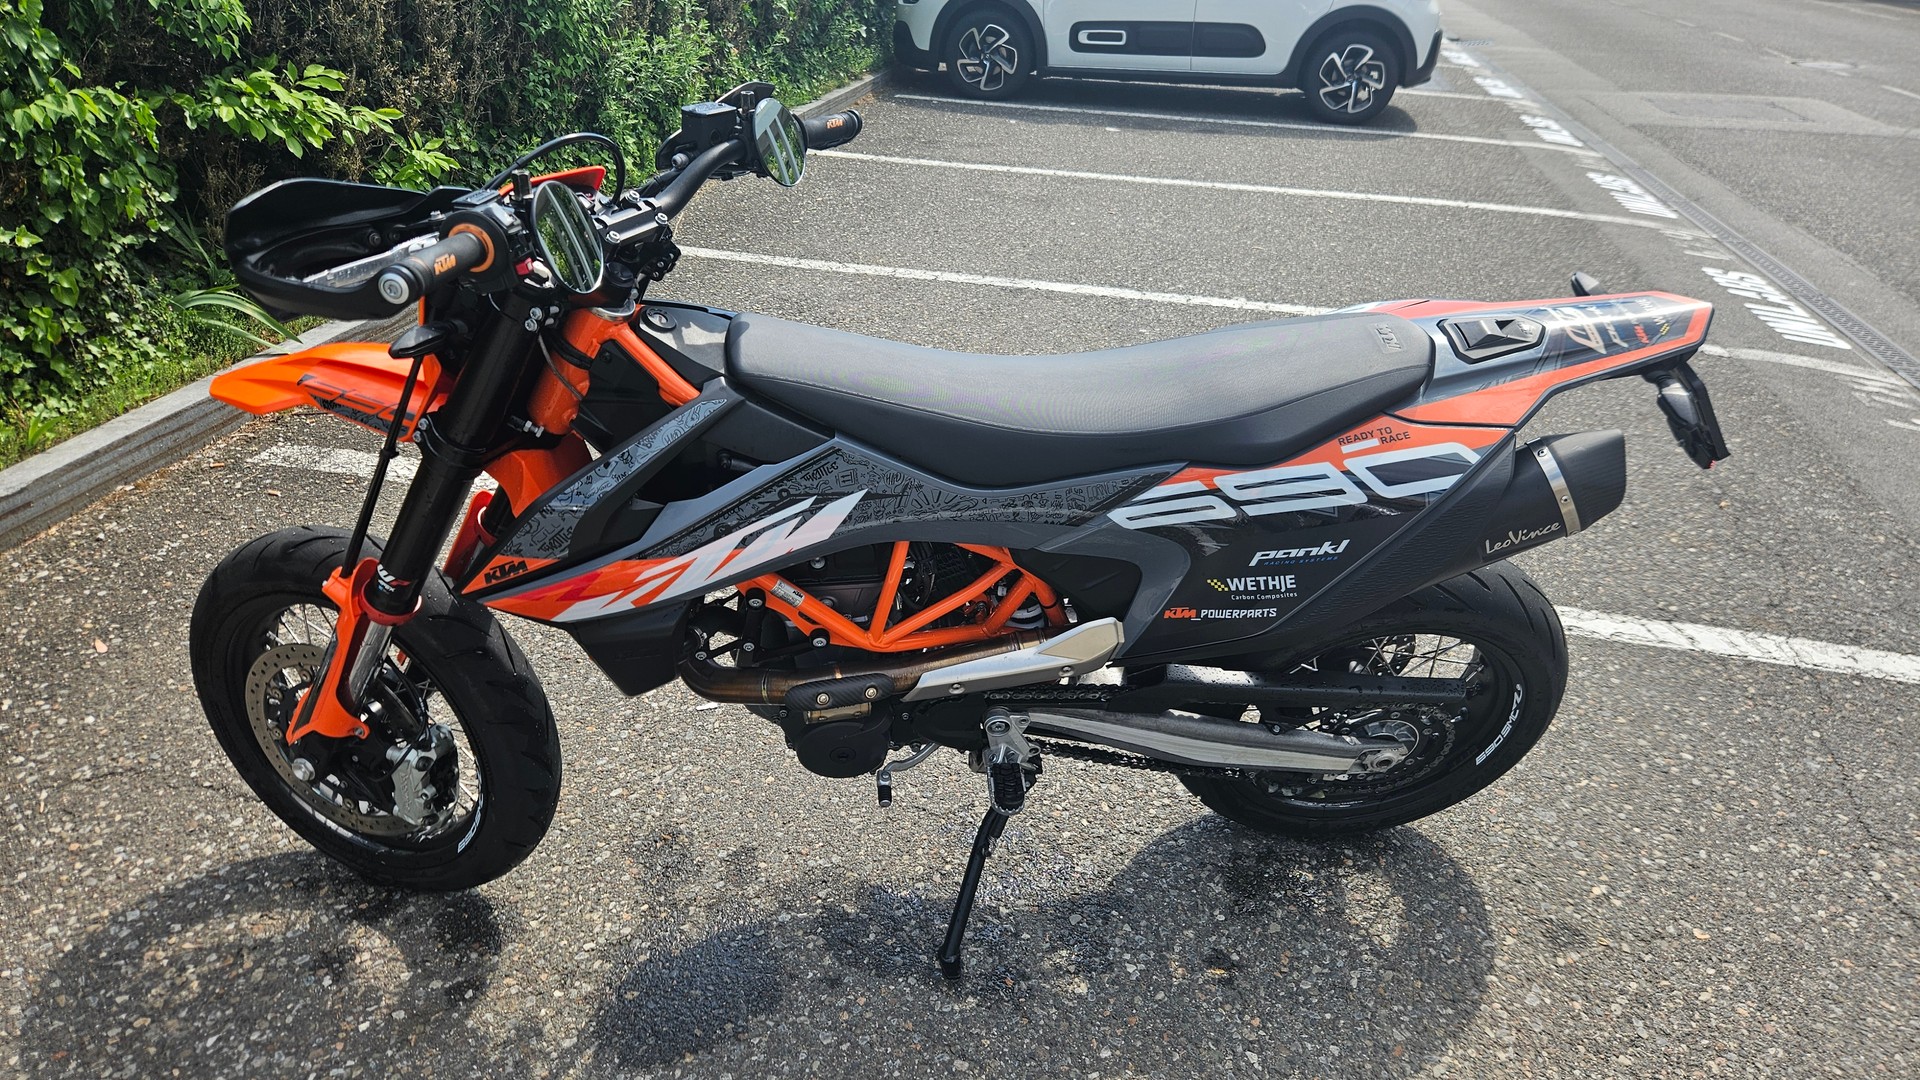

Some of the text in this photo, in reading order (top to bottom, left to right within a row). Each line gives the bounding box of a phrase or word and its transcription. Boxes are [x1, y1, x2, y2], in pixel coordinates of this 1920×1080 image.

[433, 253, 457, 276] KTM
[1337, 426, 1393, 446] READY TO
[1380, 431, 1411, 445] RACE
[1107, 441, 1482, 530] 690
[1485, 522, 1562, 554] LeoVince
[1248, 539, 1351, 567] pankl
[483, 560, 529, 585] KTM
[1226, 574, 1297, 593] WETHJE
[1231, 592, 1298, 601] Carbon Composites
